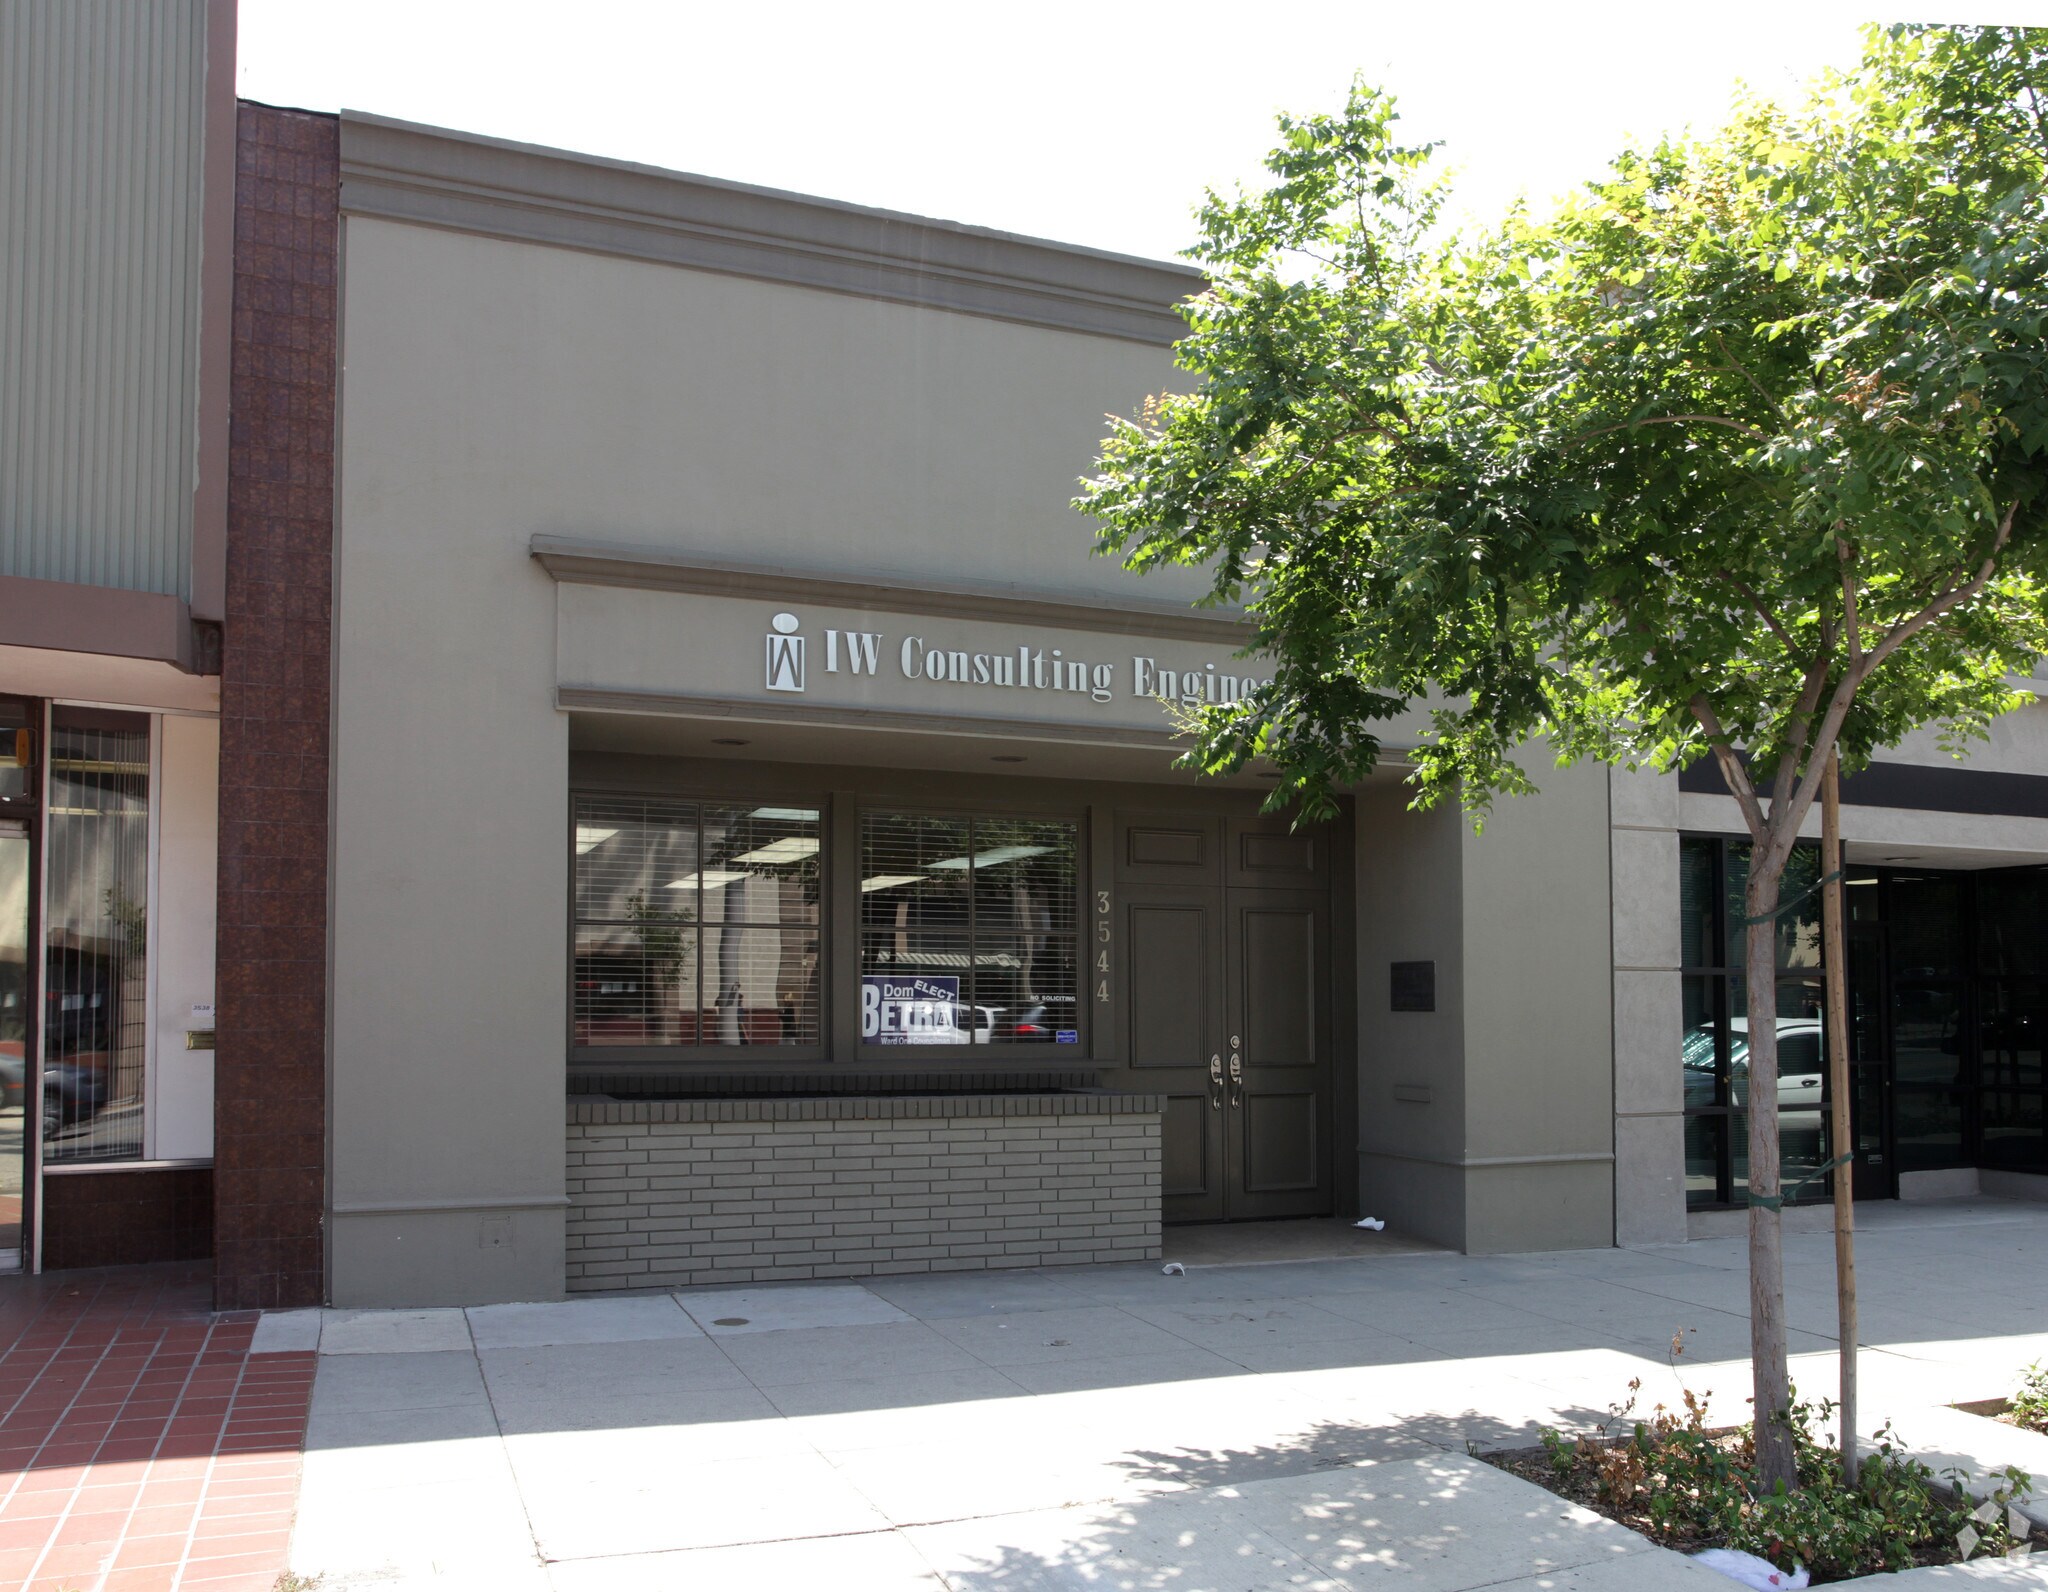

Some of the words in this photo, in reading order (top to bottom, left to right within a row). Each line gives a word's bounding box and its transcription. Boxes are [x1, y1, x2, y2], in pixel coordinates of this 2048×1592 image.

[824, 629, 884, 675] IW
[901, 636, 1114, 703] Consulting
[884, 984, 914, 997] Dom
[914, 979, 955, 1001] ELECT
[881, 1037, 898, 1045] Ward
